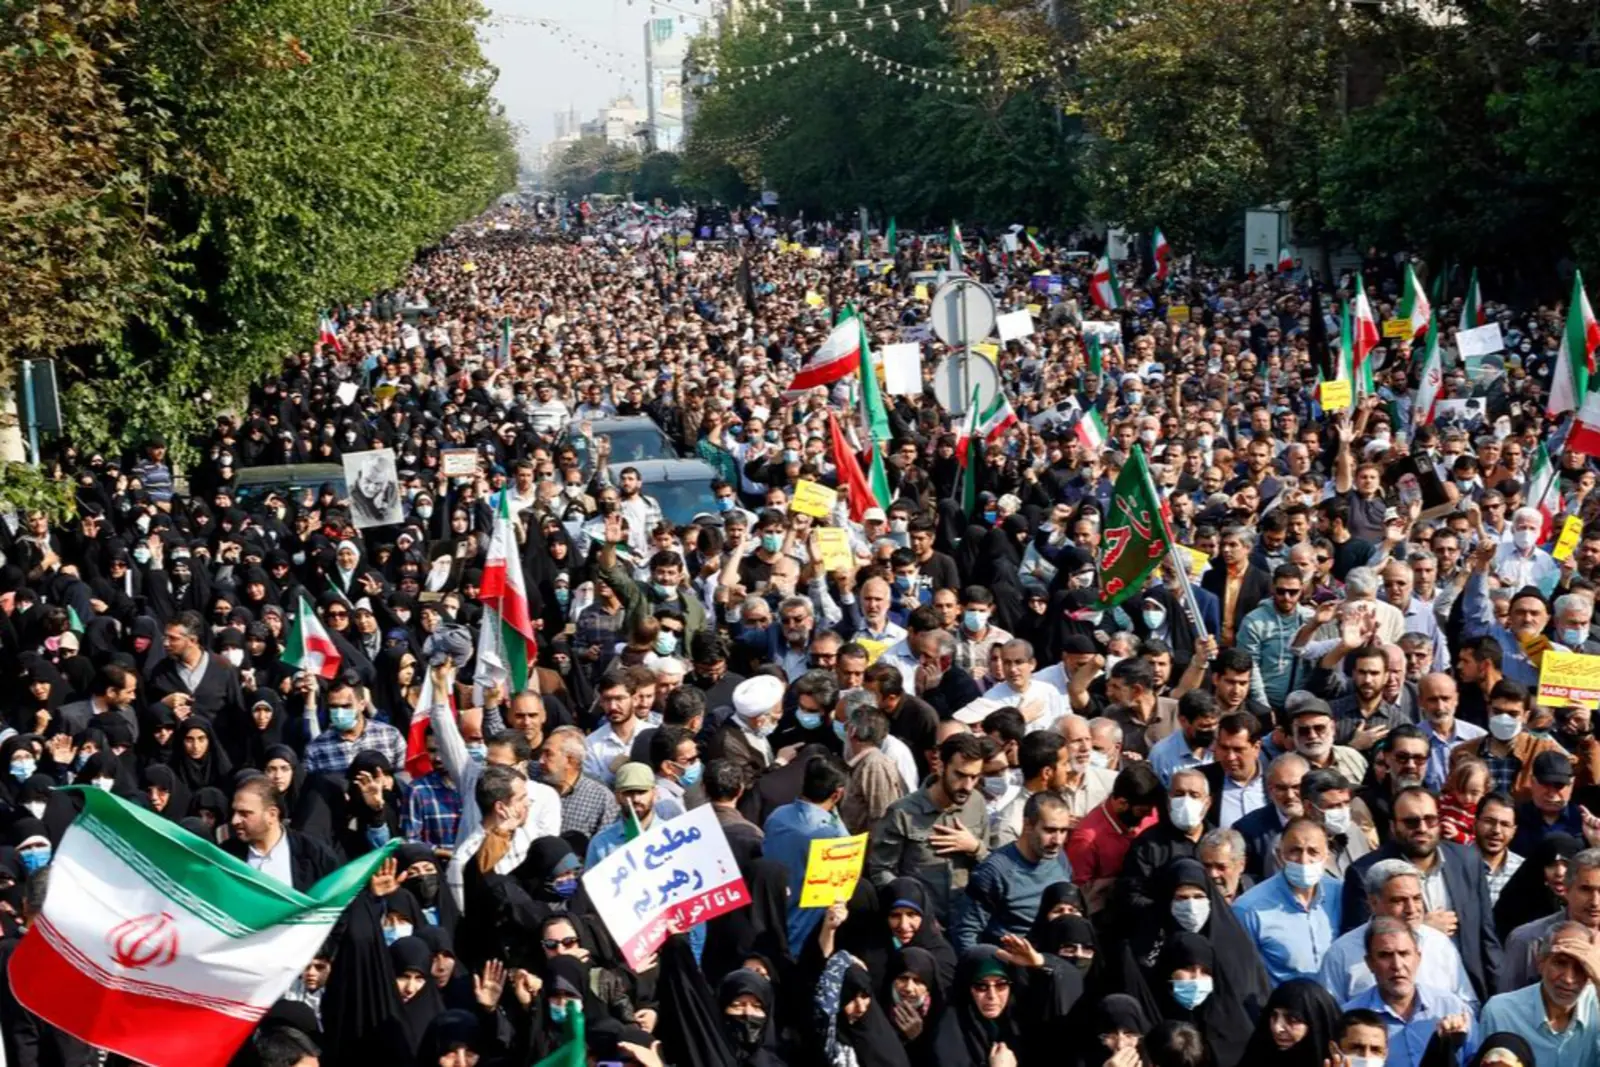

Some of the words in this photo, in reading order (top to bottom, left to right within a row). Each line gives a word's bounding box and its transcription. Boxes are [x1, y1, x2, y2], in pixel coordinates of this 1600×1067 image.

[644, 826, 701, 870] مطیع
[610, 850, 638, 898] امر
[690, 893, 713, 923] آخر
[713, 891, 726, 907] تا
[725, 887, 742, 902] ما
